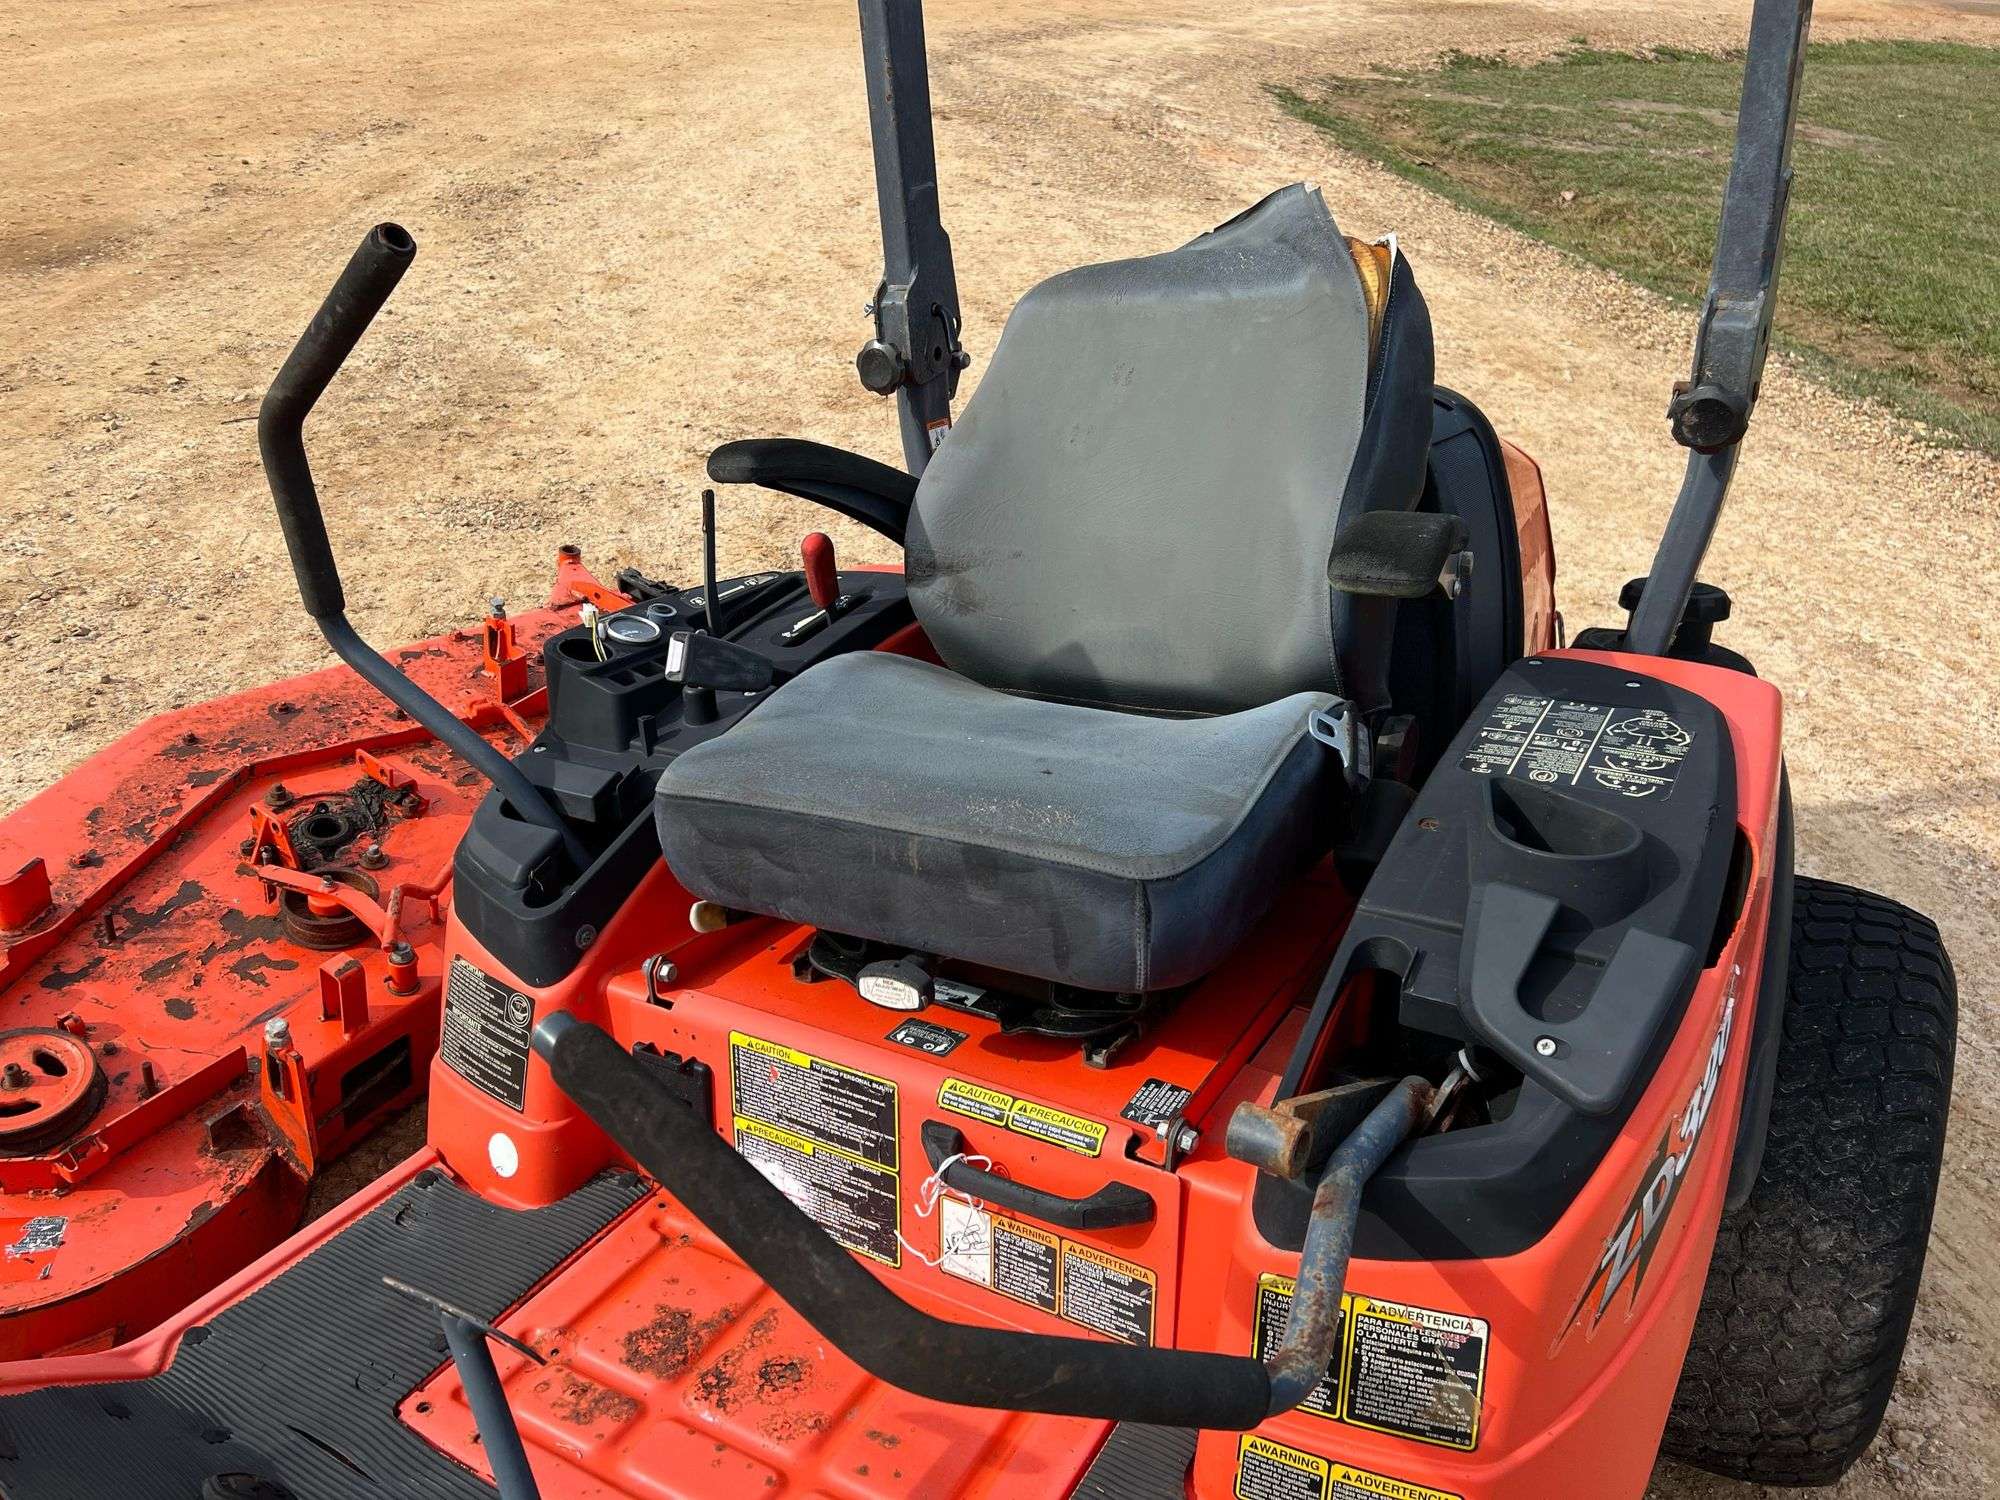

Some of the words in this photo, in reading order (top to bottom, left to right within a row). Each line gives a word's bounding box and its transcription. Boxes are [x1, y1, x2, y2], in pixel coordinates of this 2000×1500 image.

[754, 1043, 791, 1060] CAUTION
[958, 1083, 1009, 1107] CAUTION
[1028, 1106, 1102, 1136] PRECAUCIÓN
[753, 1125, 806, 1150] PRECAUCIÓN
[1006, 1220, 1052, 1244] WARNING
[1078, 1248, 1150, 1281] ADVERTENCIA
[1264, 1291, 1276, 1301] TO
[1357, 1315, 1383, 1326] PARA
[1384, 1321, 1417, 1333] EVITAR
[1379, 1306, 1474, 1332] ADVERTENCIA
[1356, 1328, 1363, 1336] O
[1365, 1330, 1378, 1339] LA
[1379, 1333, 1418, 1348] MUERTE
[1357, 1321, 1419, 1341] PERSONALES
[1420, 1335, 1460, 1349] GRAVES
[1259, 1442, 1320, 1471] WARNING
